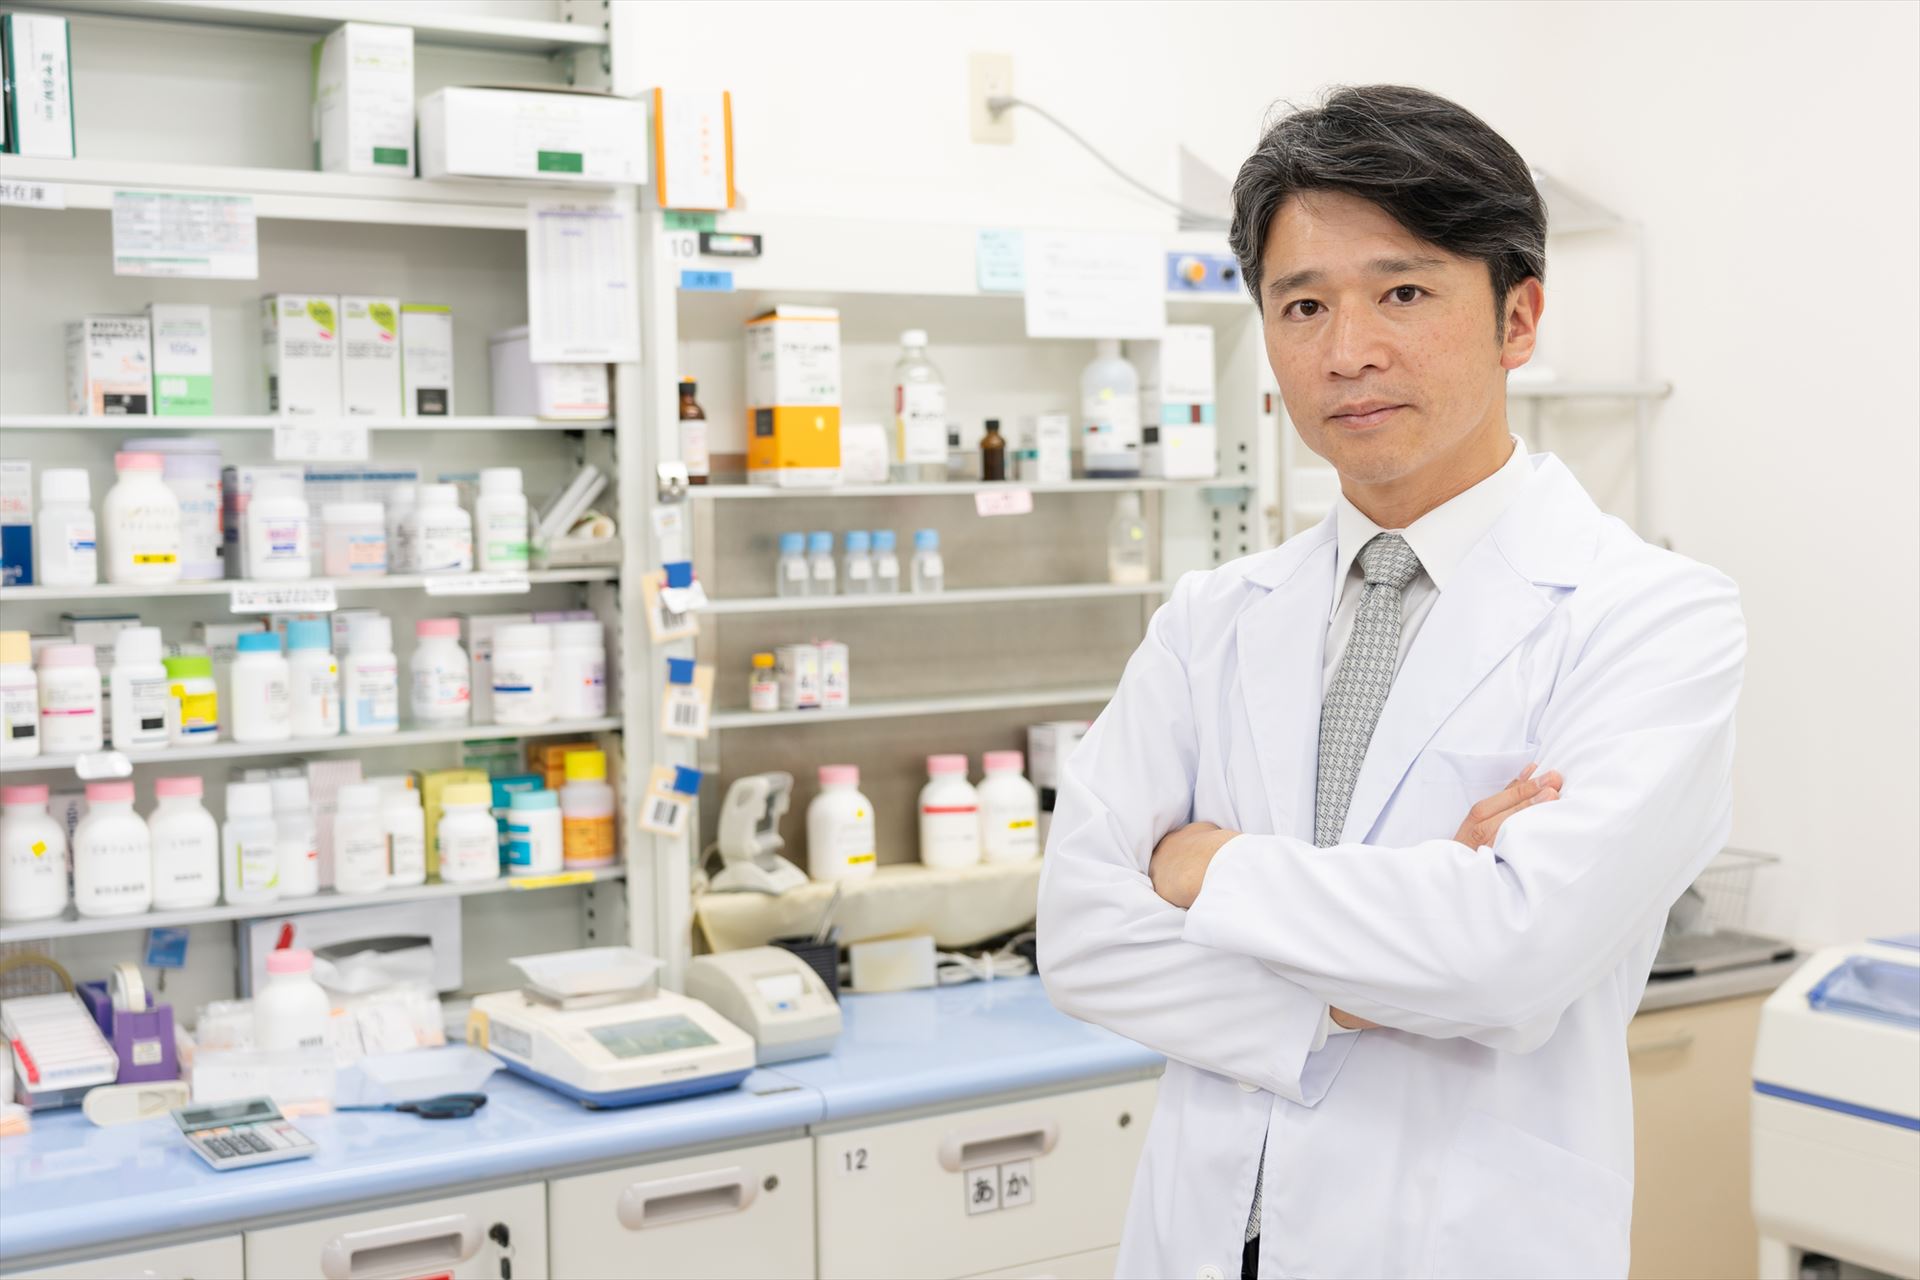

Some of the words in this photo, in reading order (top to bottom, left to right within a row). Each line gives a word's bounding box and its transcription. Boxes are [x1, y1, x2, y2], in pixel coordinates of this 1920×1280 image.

[671, 239, 695, 258] 10
[844, 1147, 869, 1171] 12
[973, 1176, 995, 1204] あ
[1006, 1172, 1030, 1198] か
